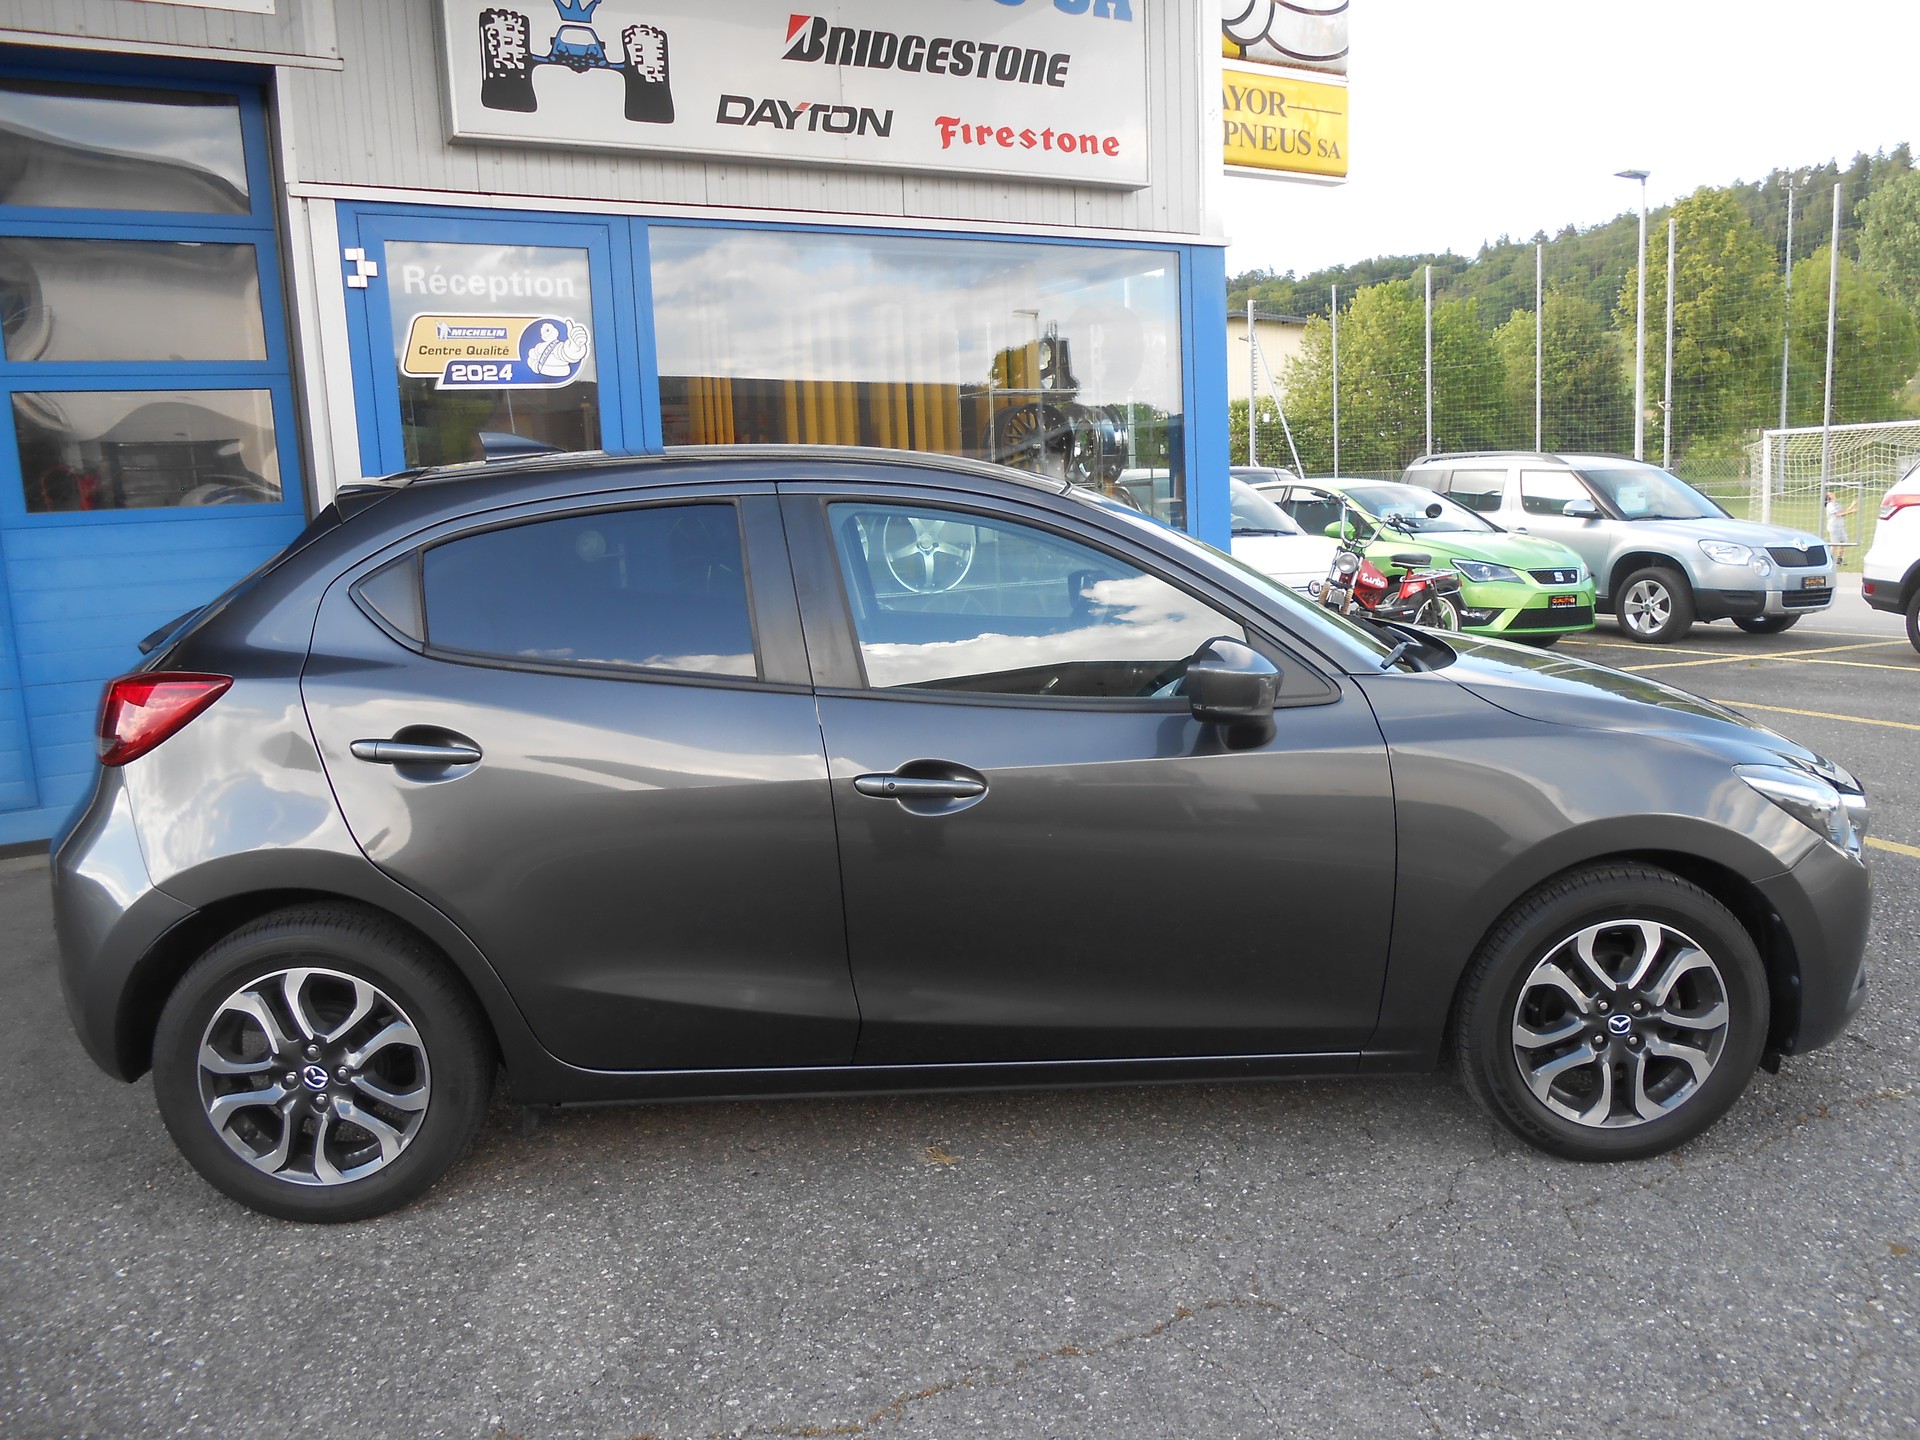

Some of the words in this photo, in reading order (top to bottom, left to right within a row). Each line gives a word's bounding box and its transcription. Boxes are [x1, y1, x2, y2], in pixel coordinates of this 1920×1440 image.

[782, 14, 1070, 87] BRIDGESTONE
[716, 94, 893, 137] DAYTON
[935, 115, 1120, 156] Firestone
[1317, 138, 1341, 159] SA
[402, 264, 575, 302] Réception
[451, 329, 505, 337] MICHELIN
[419, 345, 461, 356] Centre
[466, 345, 509, 356] Qualité
[451, 364, 513, 381] 2024
